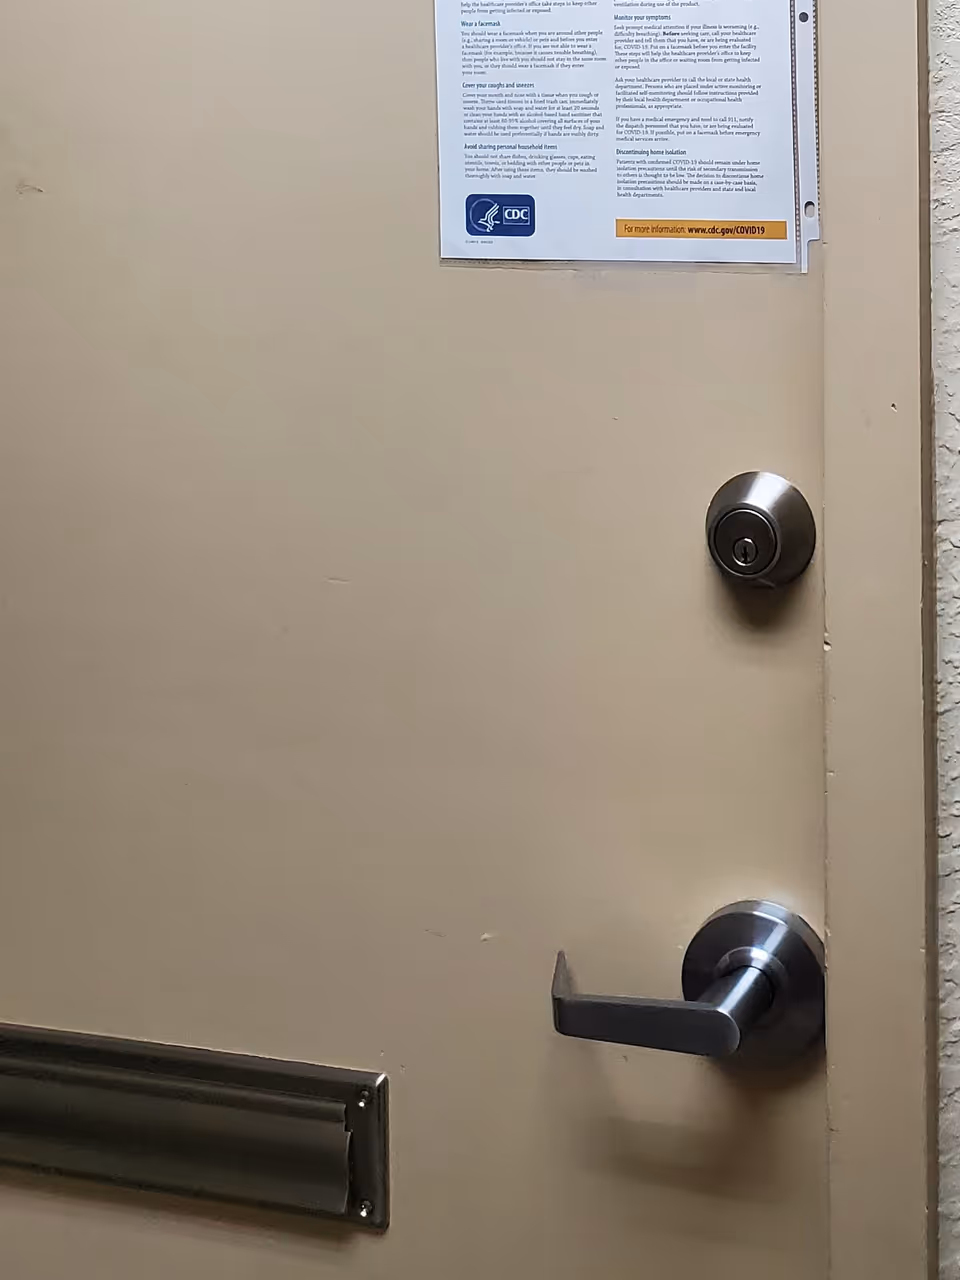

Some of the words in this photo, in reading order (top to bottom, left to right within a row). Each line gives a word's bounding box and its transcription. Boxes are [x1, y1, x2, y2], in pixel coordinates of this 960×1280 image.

[488, 82, 505, 90] coughs
[616, 148, 650, 157] Discontinuing
[504, 209, 529, 220] CDC
[624, 224, 633, 233] For
[651, 225, 685, 233] information:
[688, 225, 765, 236] www.cdc.gov/COVID19
